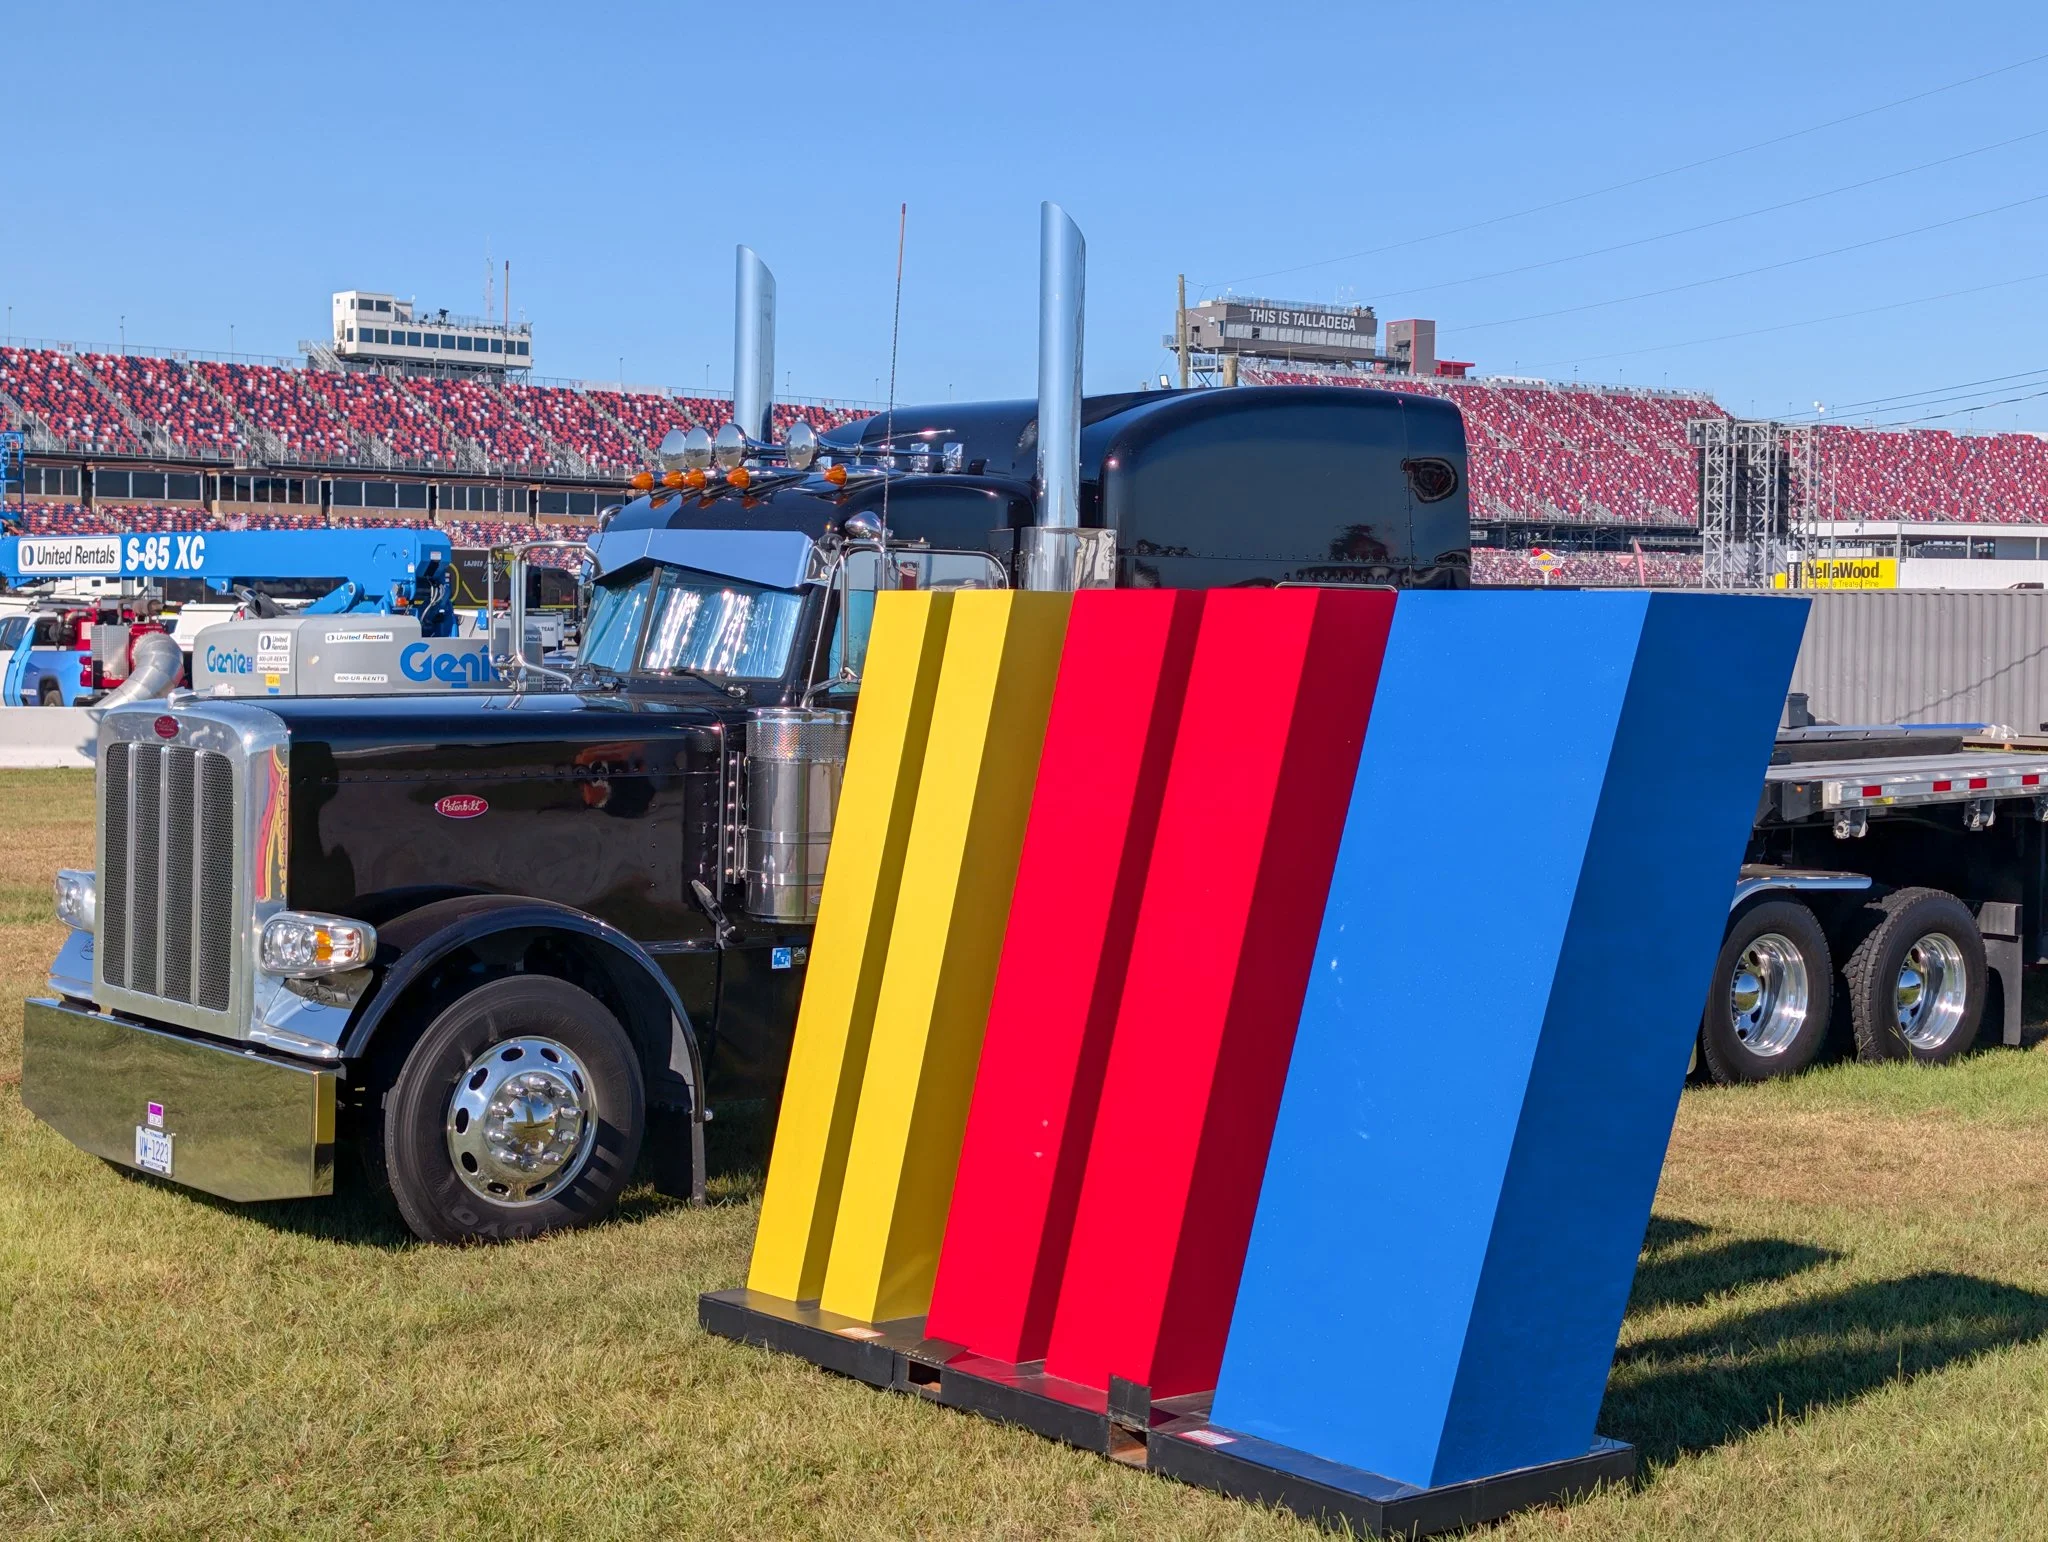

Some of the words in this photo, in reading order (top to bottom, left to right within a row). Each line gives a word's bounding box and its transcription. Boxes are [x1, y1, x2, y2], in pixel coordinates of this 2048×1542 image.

[1249, 308, 1276, 324] THIS
[1278, 310, 1290, 325] IS
[1292, 312, 1356, 331] TALLADEGA
[37, 545, 73, 566] United
[74, 544, 115, 565] Rentals
[125, 536, 171, 571] S-85
[174, 535, 205, 571] XC
[1838, 580, 1863, 588] Treated
[1864, 580, 1880, 588] Pine
[271, 643, 288, 651] Rentals
[272, 635, 288, 643] United
[206, 645, 246, 674] Genie
